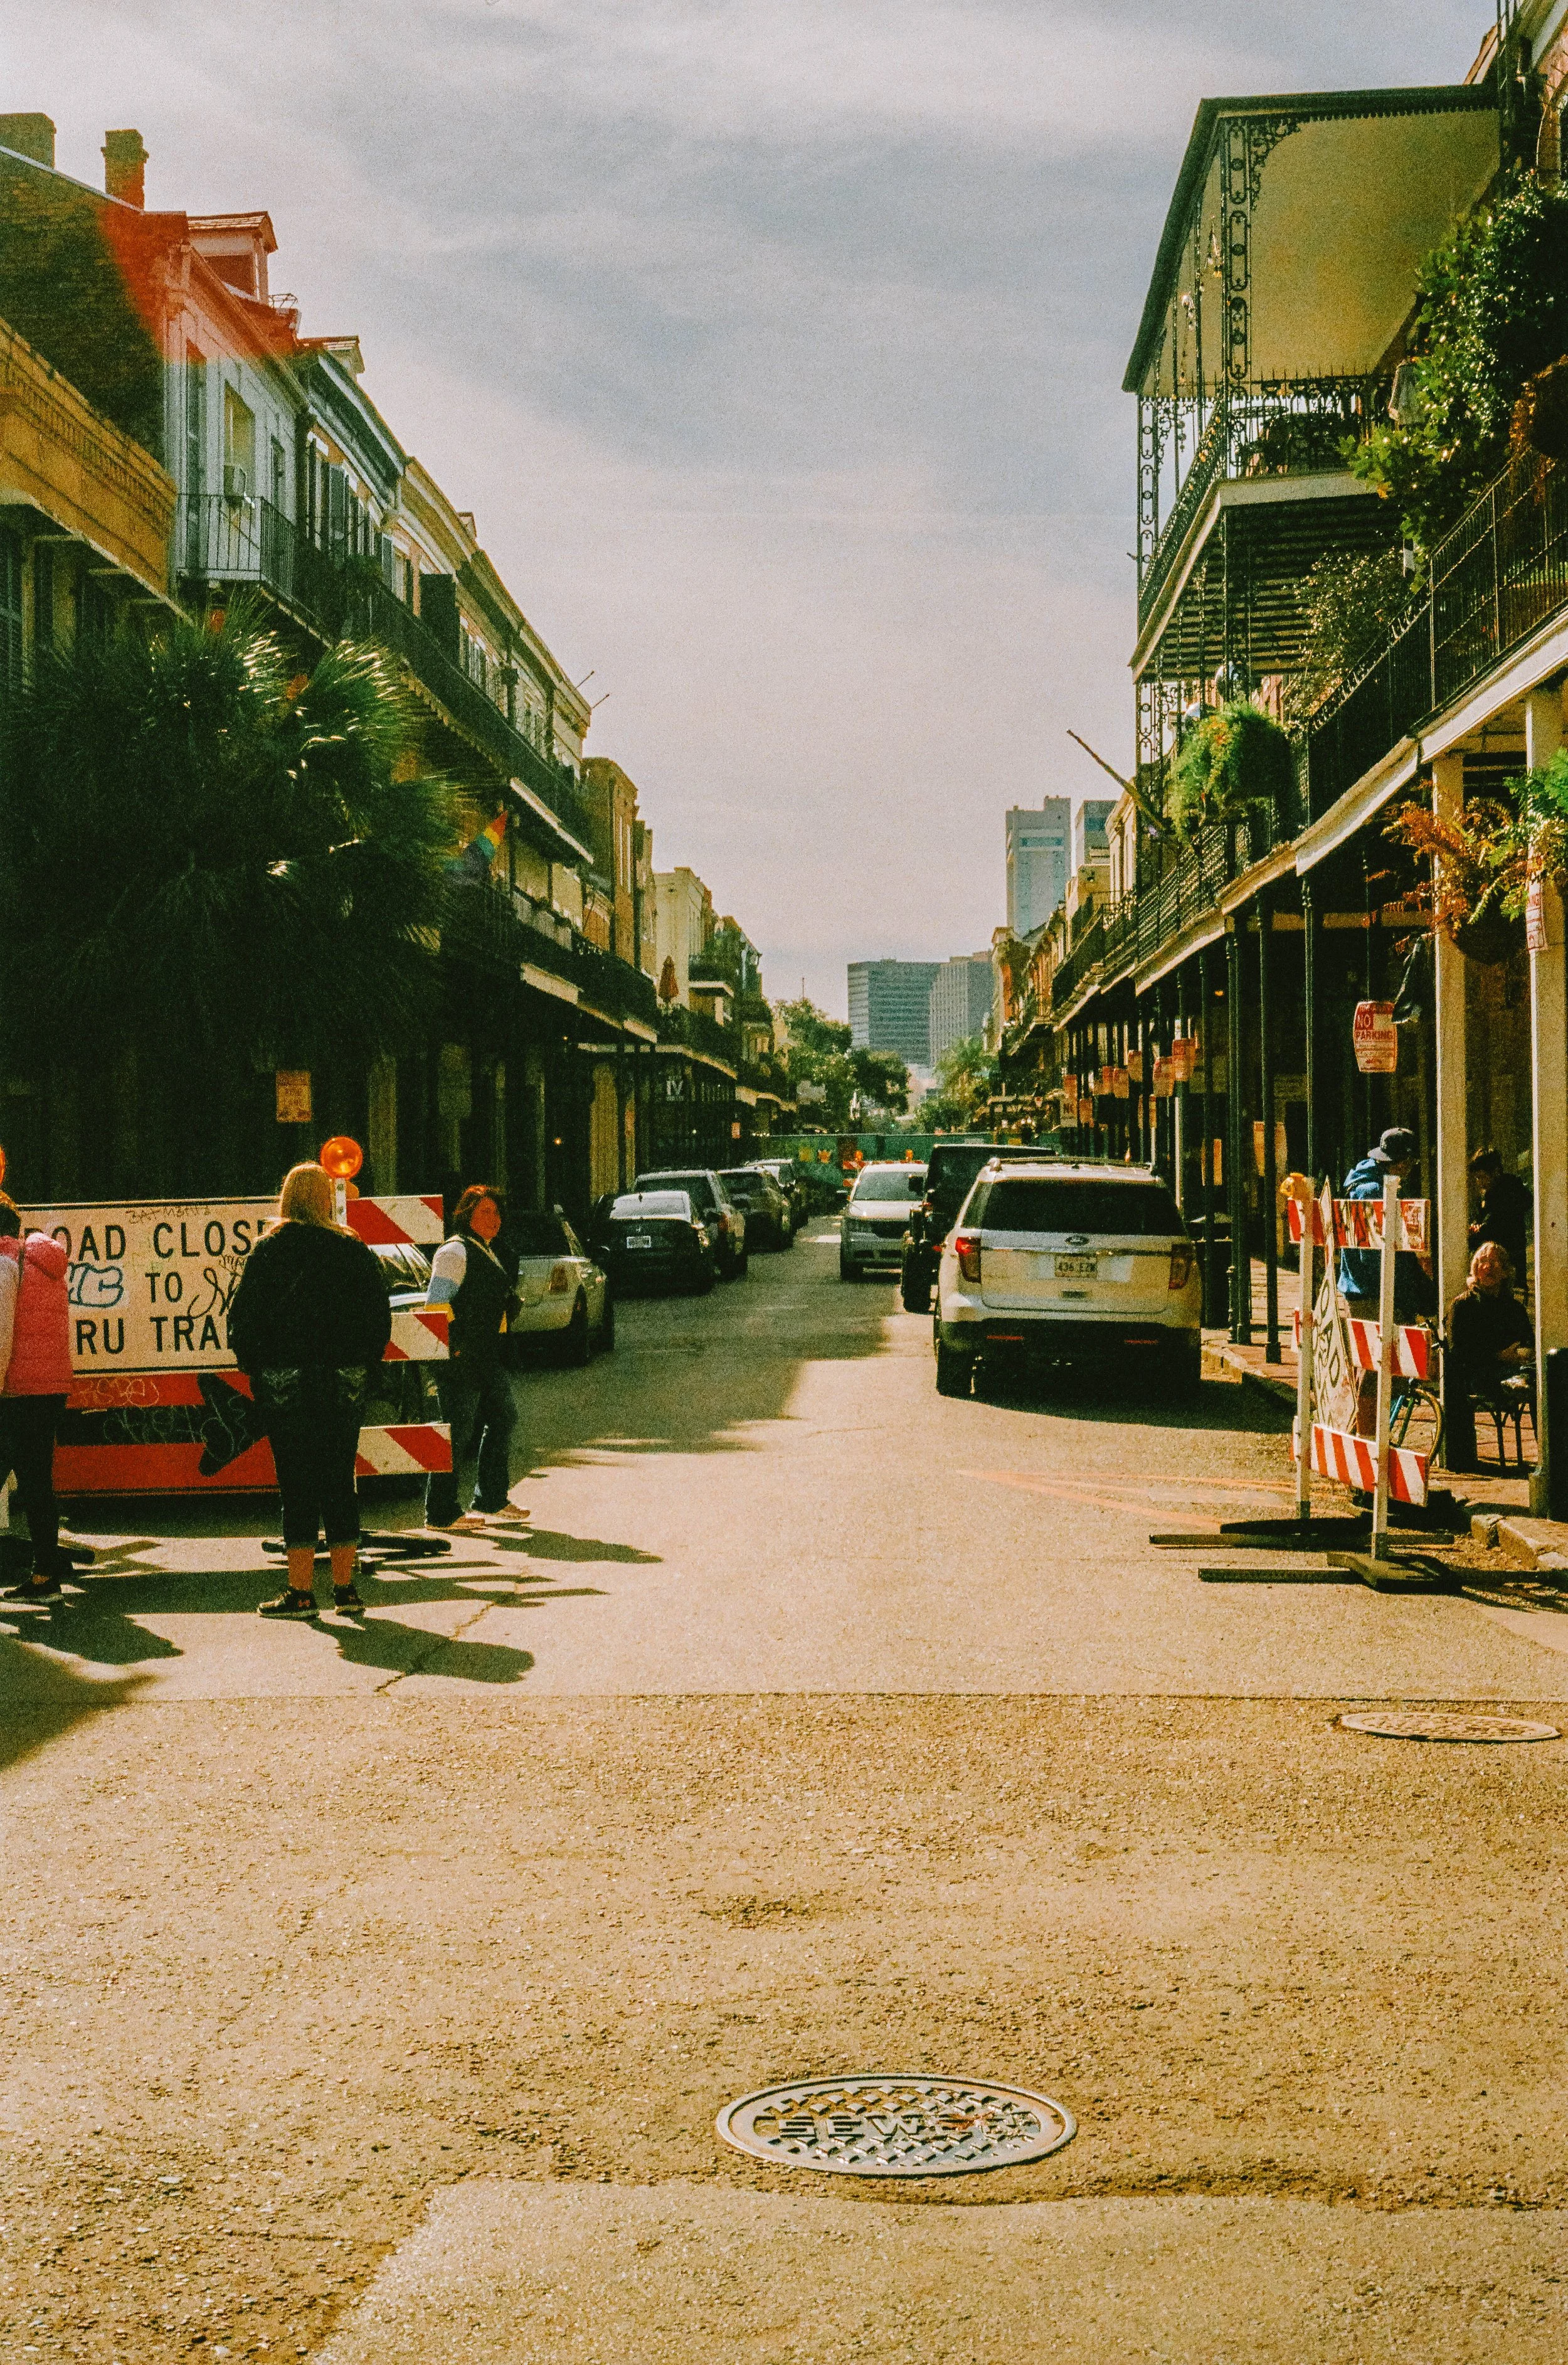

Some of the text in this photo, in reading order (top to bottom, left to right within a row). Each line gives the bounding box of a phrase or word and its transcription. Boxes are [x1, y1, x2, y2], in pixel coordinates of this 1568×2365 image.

[1355, 1030, 1393, 1040] PARKING
[1357, 1014, 1371, 1028] NO
[24, 1220, 266, 1262] OAD CLOS
[145, 1272, 183, 1304] TO
[76, 1318, 125, 1355] RU
